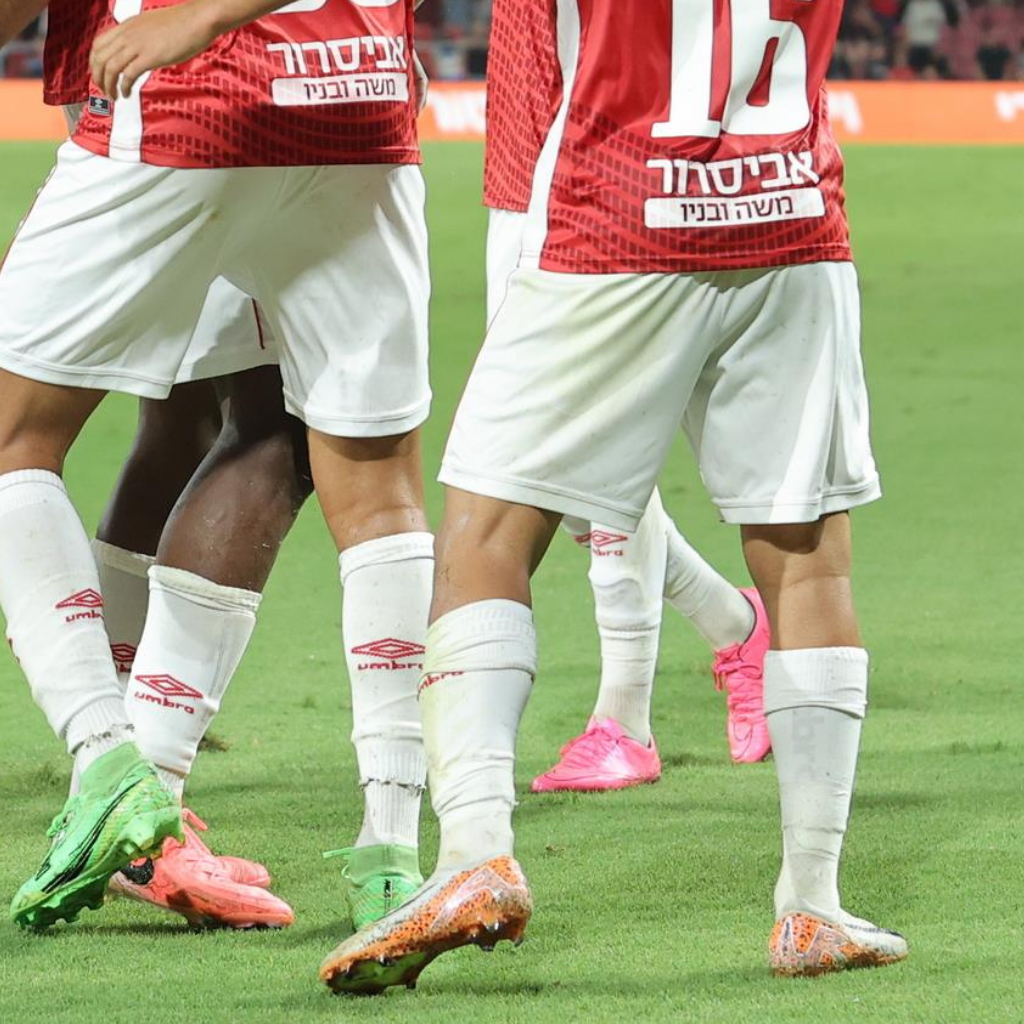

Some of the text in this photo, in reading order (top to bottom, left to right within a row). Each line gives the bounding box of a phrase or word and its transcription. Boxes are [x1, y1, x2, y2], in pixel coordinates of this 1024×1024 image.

[266, 36, 407, 74] אביסרור
[304, 78, 396, 100] משה ובניו
[646, 151, 820, 195] אביסרור
[680, 195, 793, 222] משה ובניו
